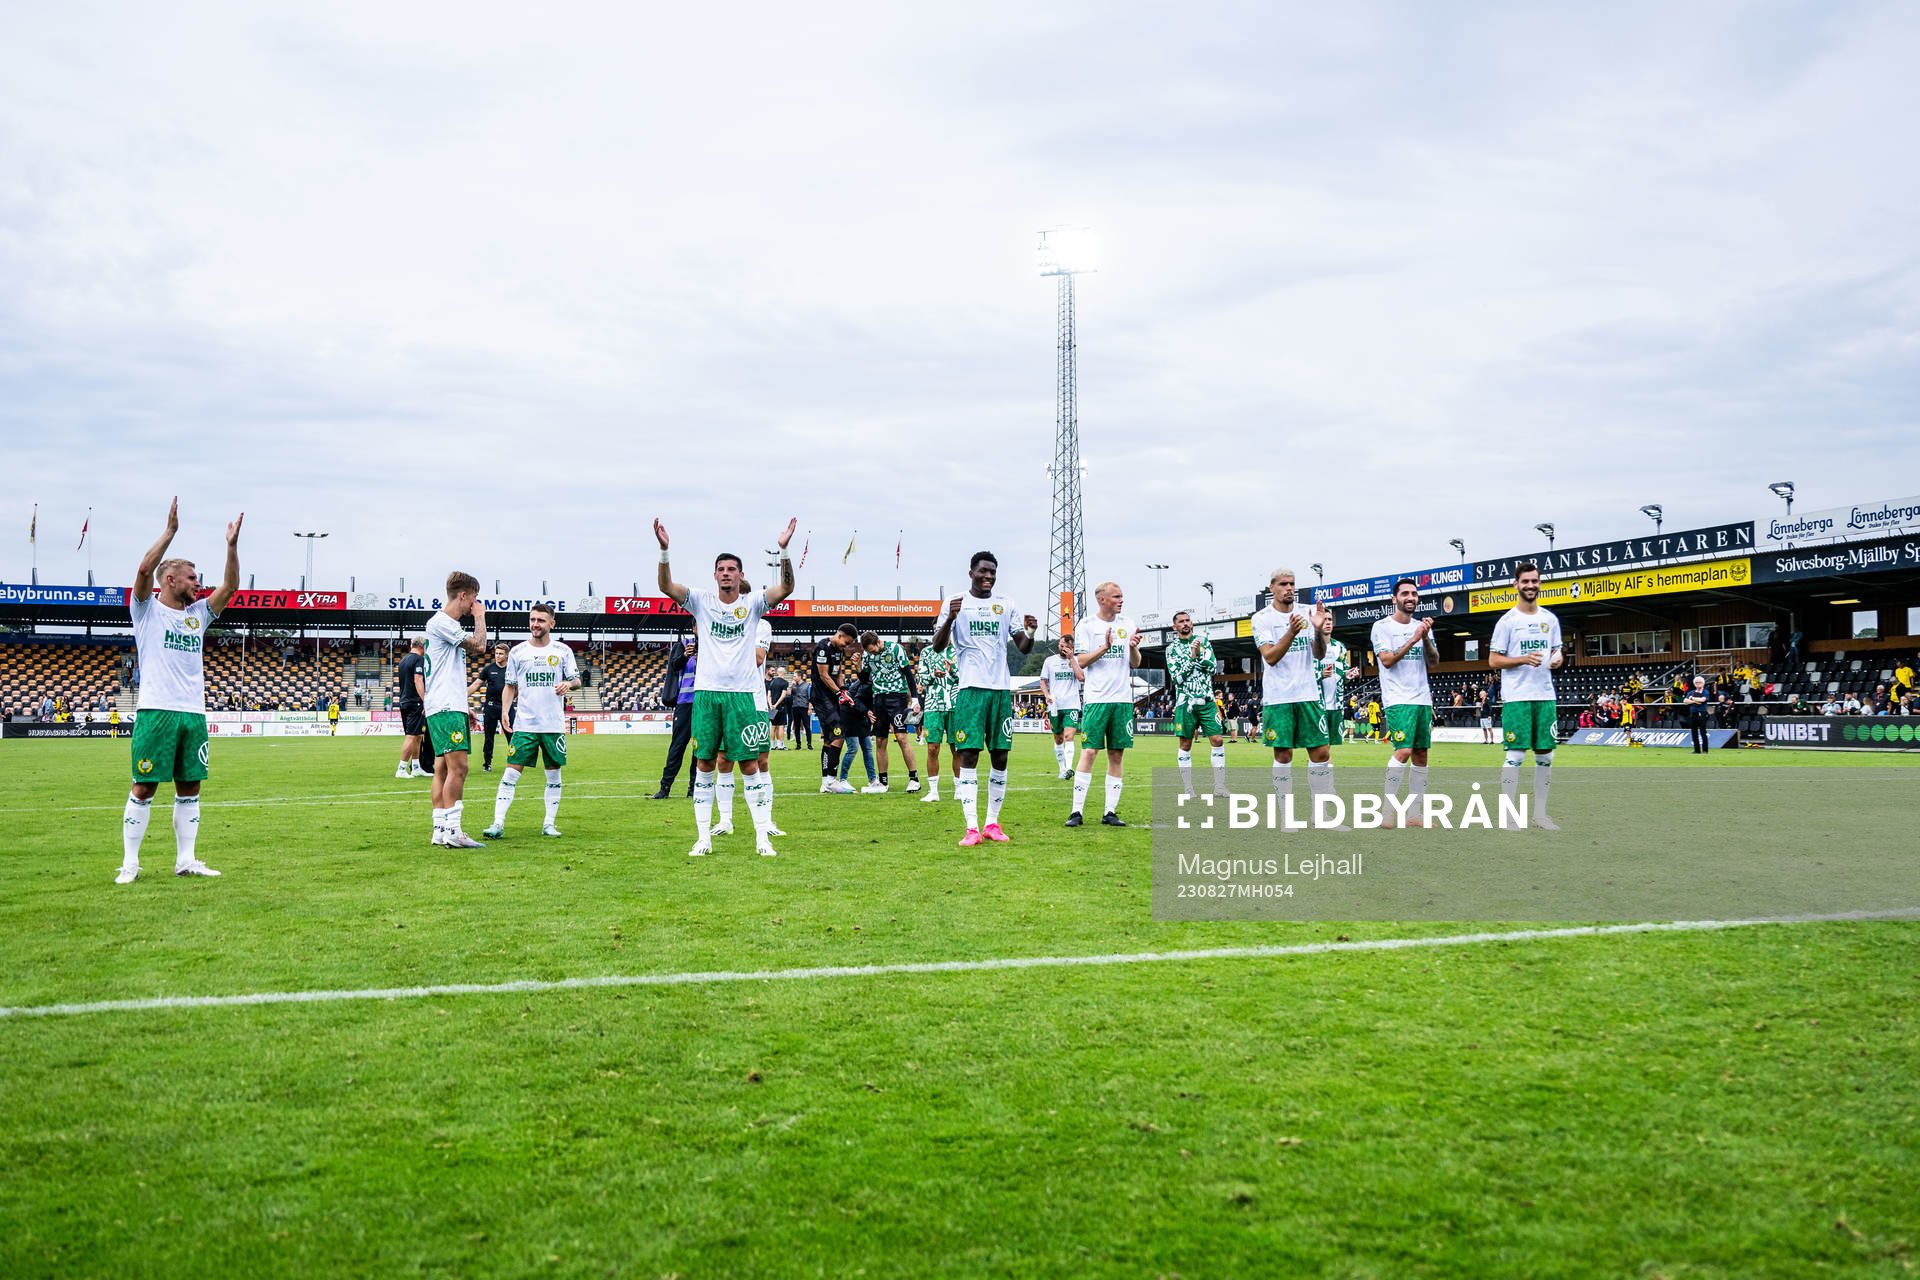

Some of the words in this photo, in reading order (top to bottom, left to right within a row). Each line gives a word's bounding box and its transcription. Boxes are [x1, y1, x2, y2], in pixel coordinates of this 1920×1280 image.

[1847, 504, 1920, 529] Lönneberga
[1767, 517, 1833, 540] Lönneberga
[1776, 545, 1900, 573] Sölvesborg-Mjällby
[1584, 580, 1622, 595] Mjällby
[1657, 568, 1728, 586] hemmaplan
[297, 592, 338, 607] EXTRA
[389, 595, 424, 609] STÅL
[432, 599, 442, 609] &
[1480, 590, 1519, 606] Sölvesbor
[1538, 587, 1567, 599] mmun
[613, 598, 651, 612] EXTRA
[811, 604, 835, 612] Enkla
[836, 604, 879, 614] Elbolagets
[880, 604, 933, 614] familjehörna
[1347, 604, 1396, 621] Sölvesborg-Mjäll
[711, 621, 744, 635] HUSKI
[164, 630, 200, 647] HUSK
[1520, 639, 1548, 650] HUSKI
[164, 642, 200, 653] CHOCOLAT
[525, 672, 556, 682] HUSKI
[1765, 723, 1831, 741] UNIBET
